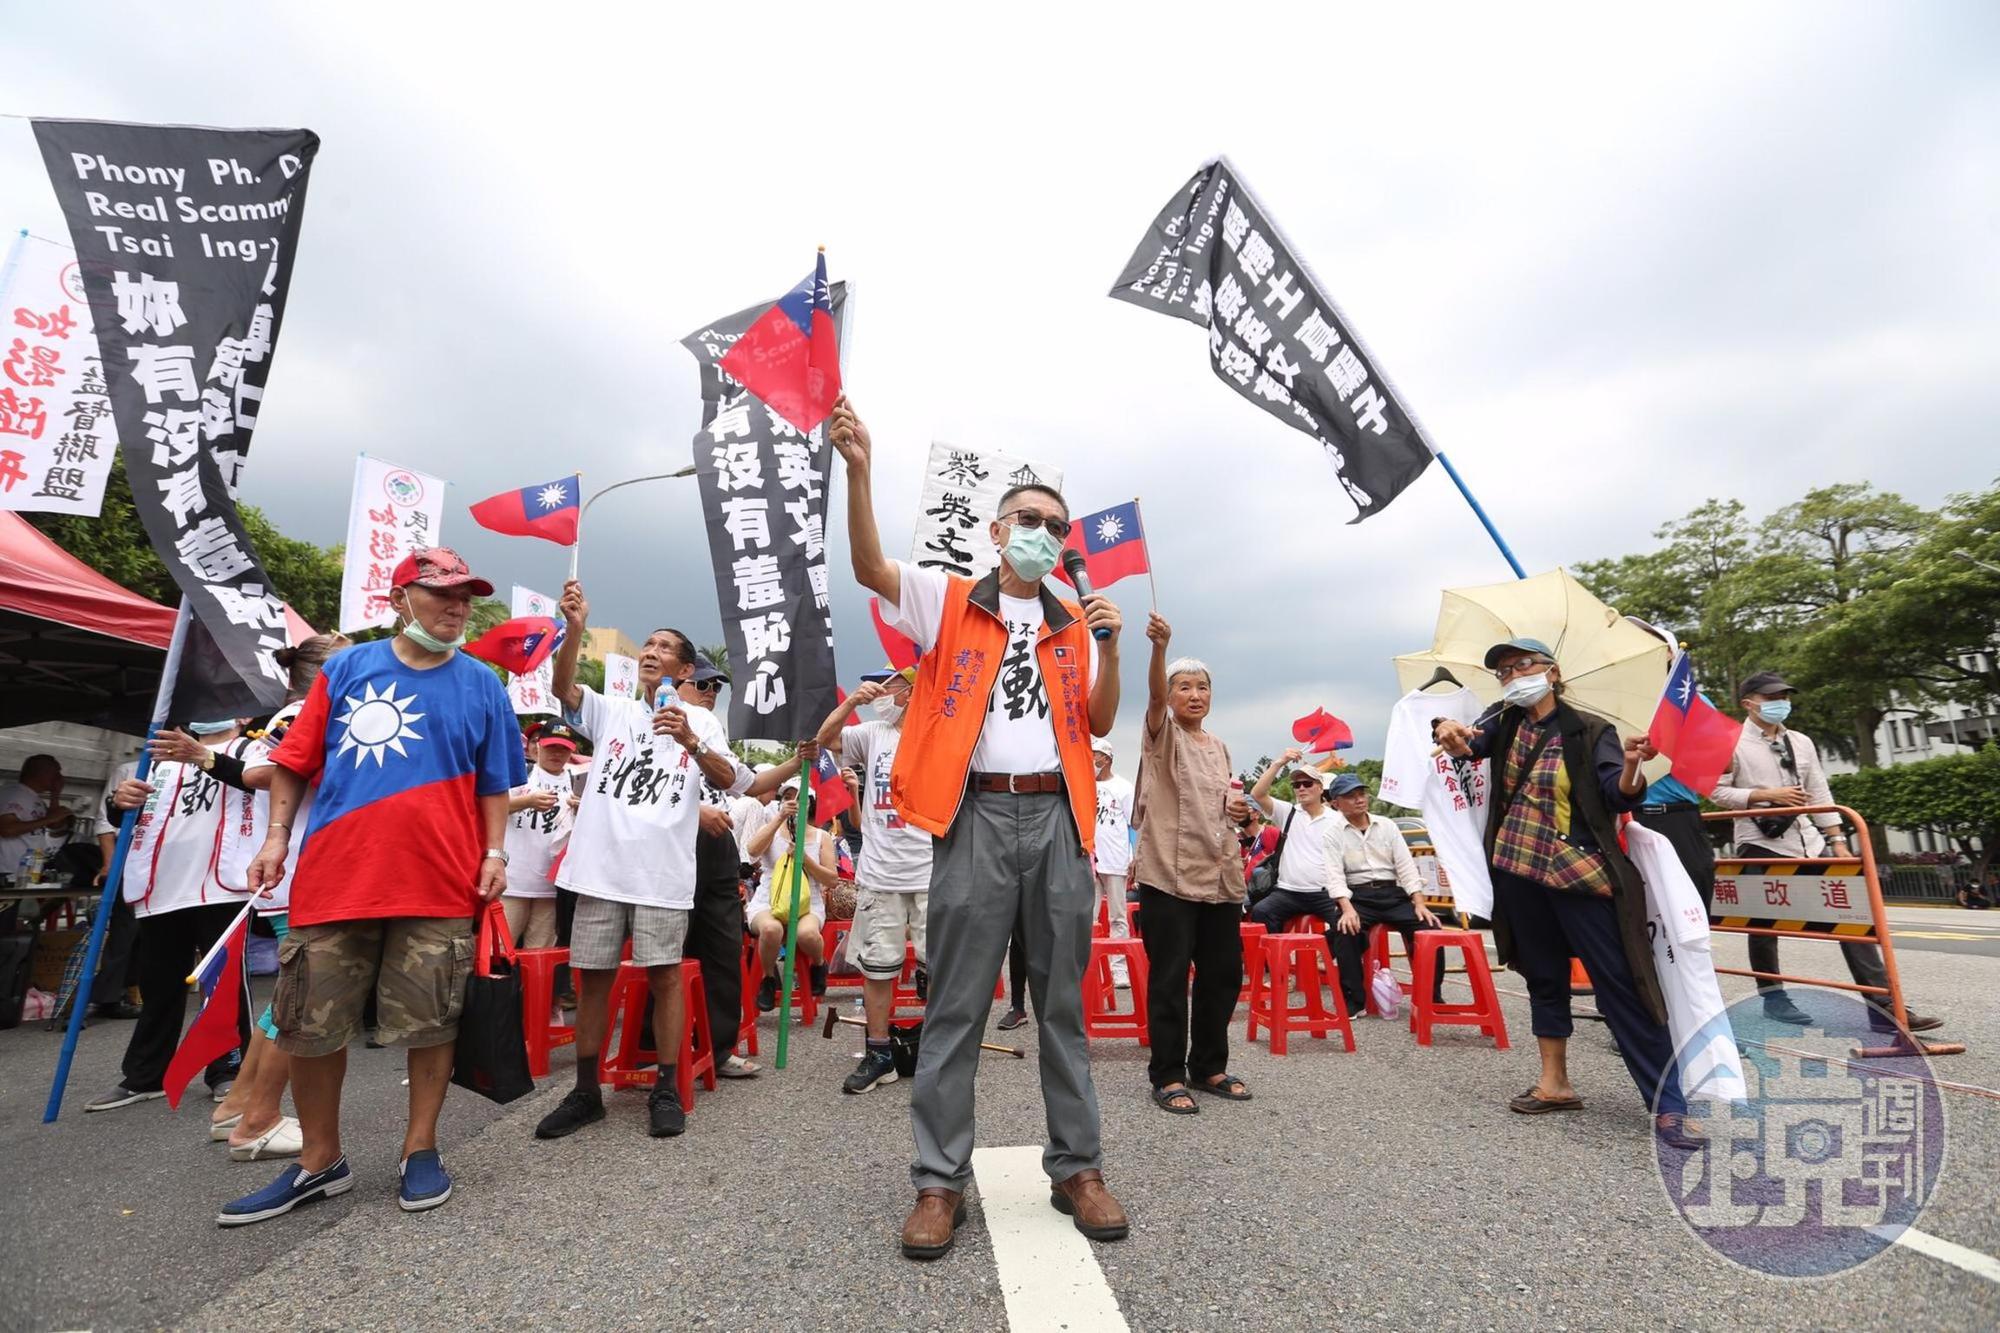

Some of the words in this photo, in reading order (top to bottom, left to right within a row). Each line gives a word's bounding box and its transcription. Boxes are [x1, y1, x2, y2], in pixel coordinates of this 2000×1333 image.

[71, 152, 185, 192] Phony
[207, 158, 262, 185] Ph.
[85, 191, 169, 223] Real
[175, 194, 292, 224] Scamm
[94, 225, 175, 258] Tsai
[1130, 245, 1171, 293] Phony
[1164, 215, 1185, 237] Ph
[1168, 266, 1193, 304] Tsai
[1186, 178, 1229, 255] Ing-wen
[1150, 261, 1179, 300] Real
[1213, 271, 1301, 389] 蔡英文
